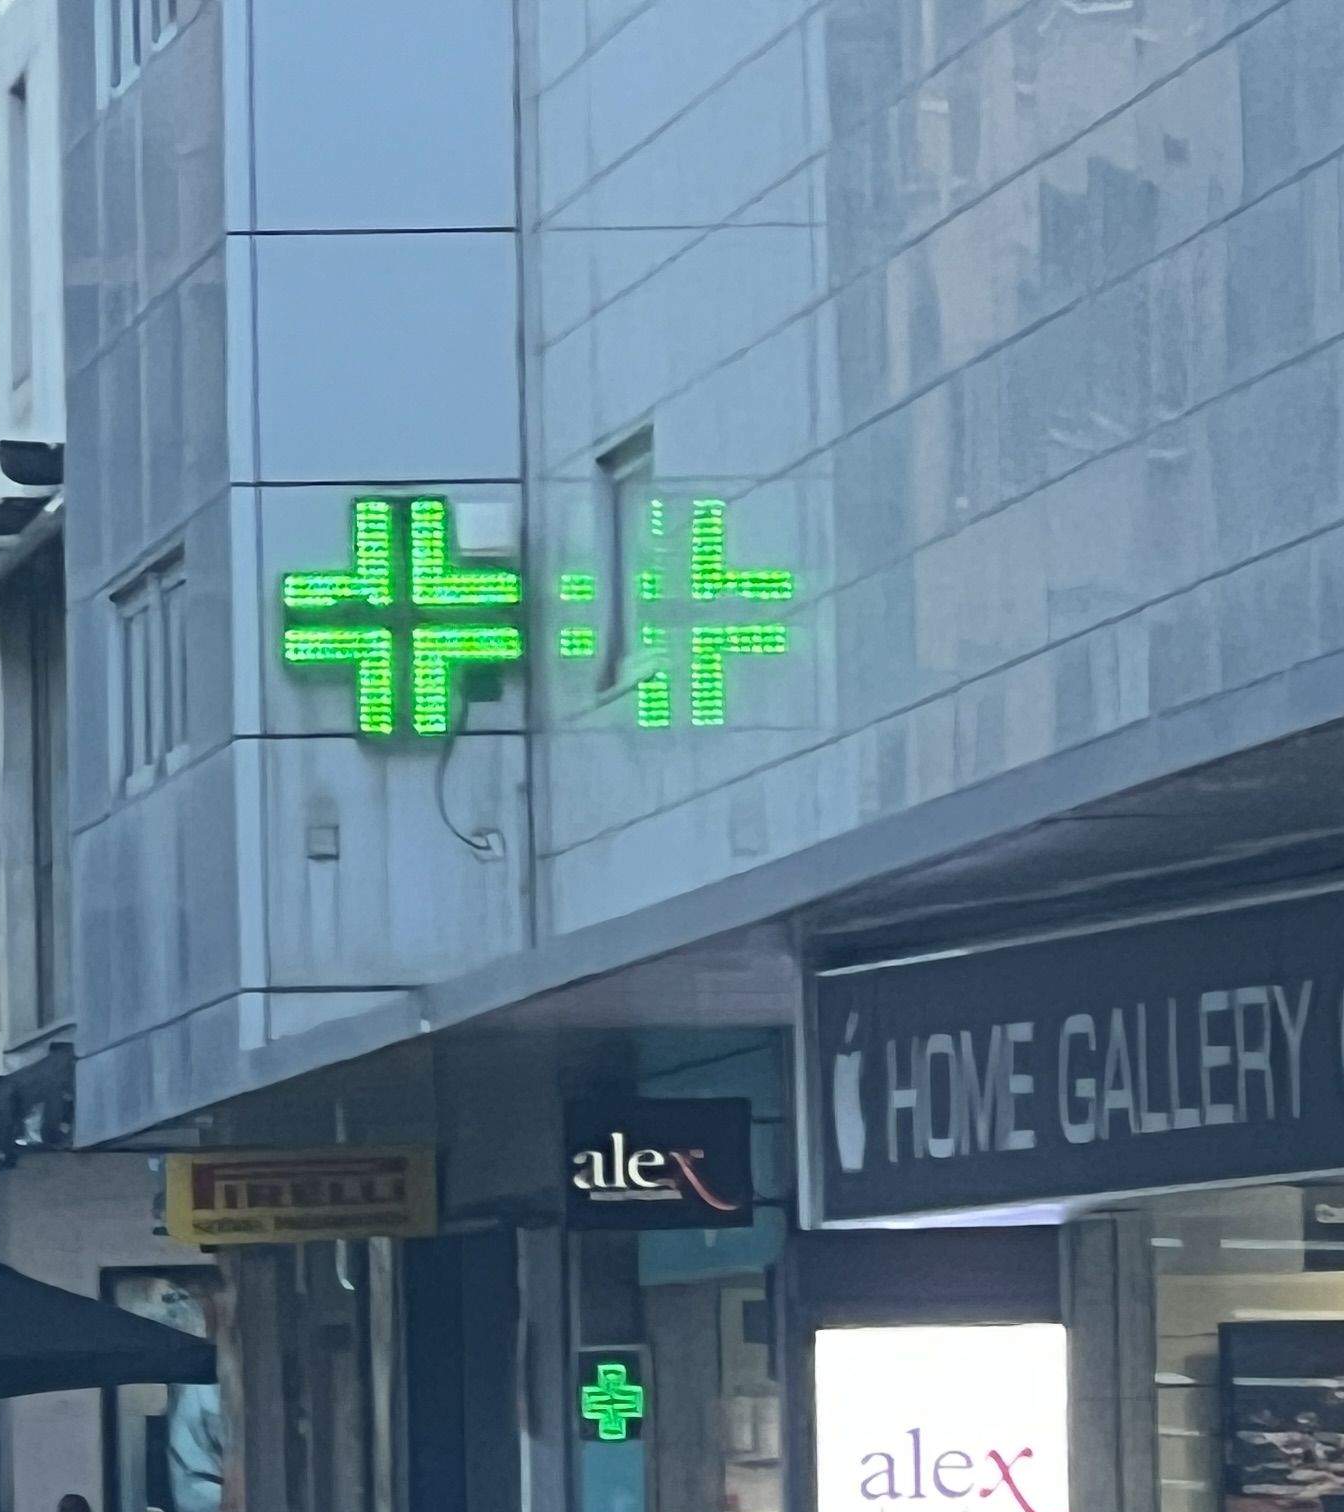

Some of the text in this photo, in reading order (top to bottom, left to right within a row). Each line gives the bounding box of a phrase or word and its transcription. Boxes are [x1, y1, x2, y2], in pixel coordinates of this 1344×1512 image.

[887, 980, 1314, 1162] HOME GALLERY
[572, 1132, 740, 1211] alex
